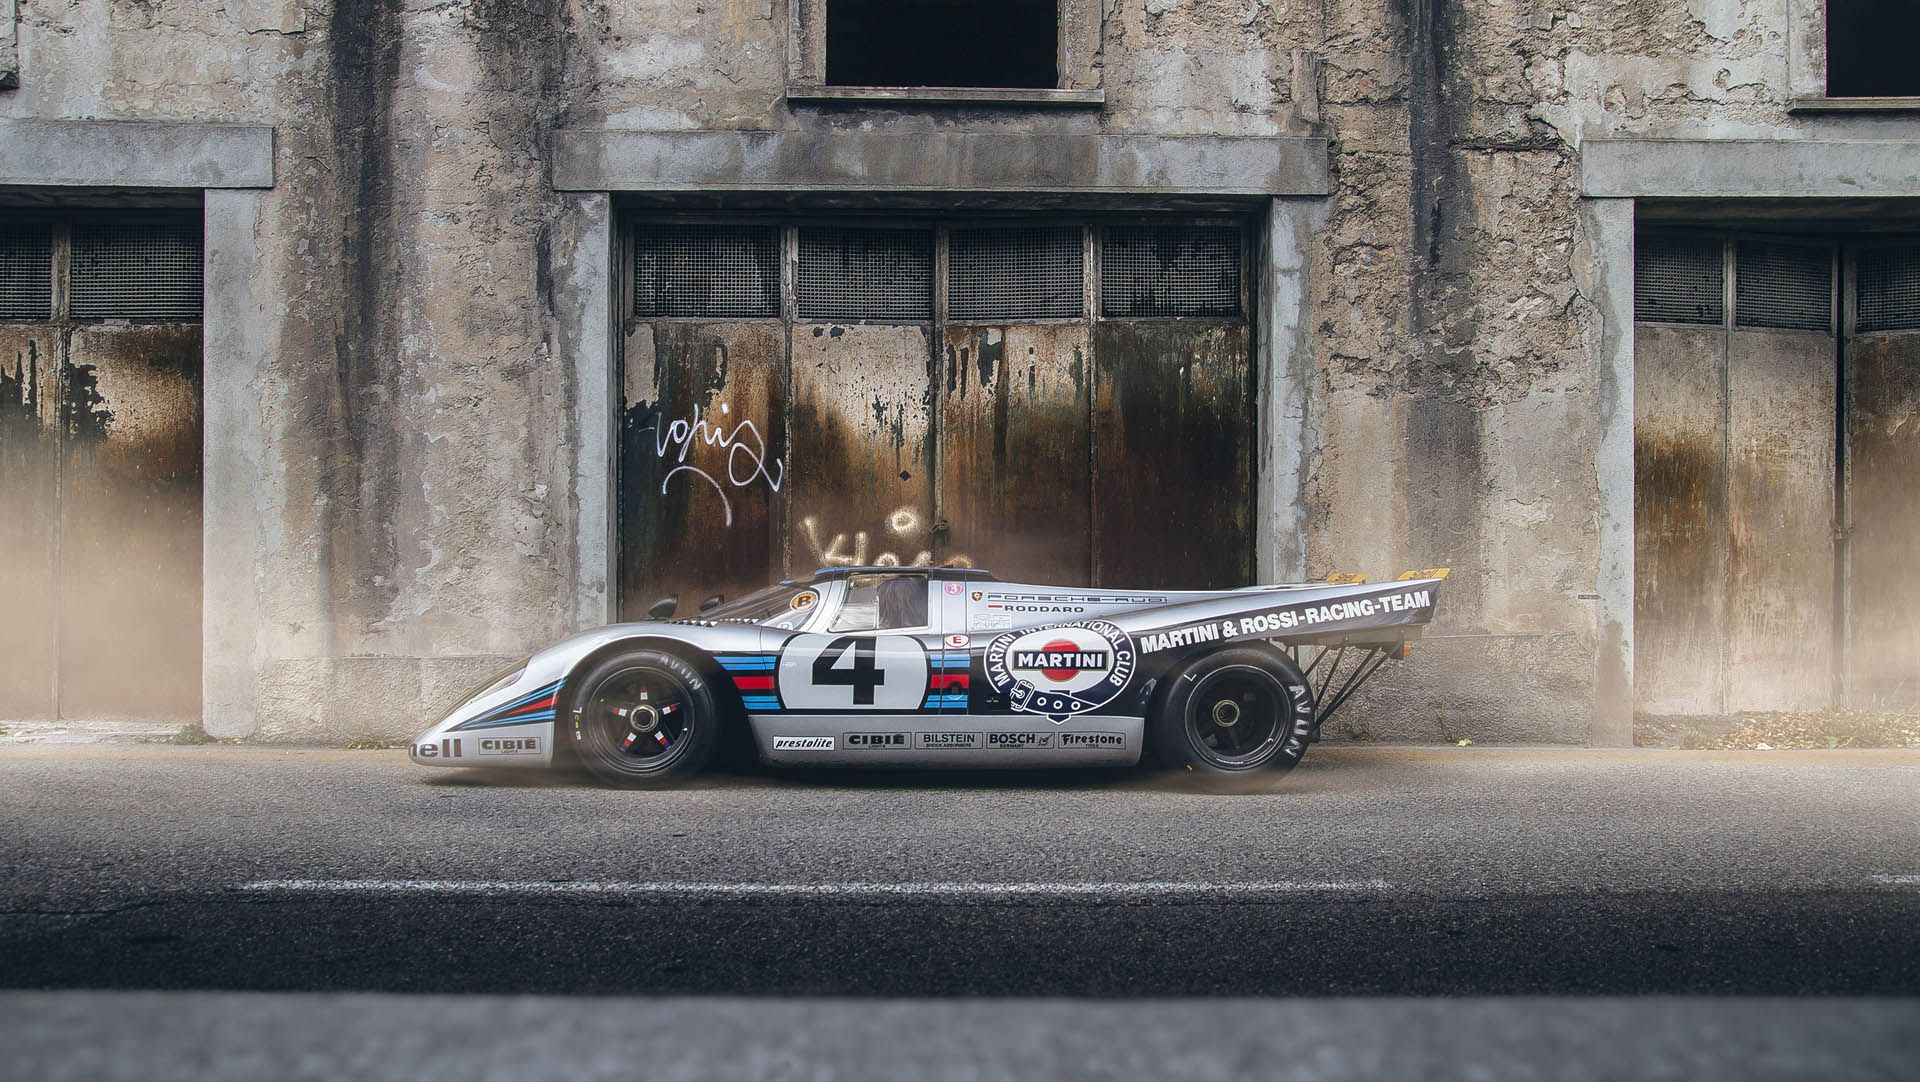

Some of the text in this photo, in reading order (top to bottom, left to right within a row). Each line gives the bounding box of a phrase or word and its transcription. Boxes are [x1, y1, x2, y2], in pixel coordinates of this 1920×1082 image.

[1004, 605, 1085, 613] RODDARO
[1140, 590, 1431, 654] MARTINI & ROSSI-RACING-TEAM
[952, 636, 962, 645] E
[989, 633, 1017, 687] MARTINI
[1020, 620, 1126, 650] INTERNATIONAL
[1109, 650, 1131, 687] CLUB
[1018, 653, 1103, 667] MARTINI
[812, 636, 885, 705] 4
[775, 738, 832, 749] prestolite
[923, 733, 975, 743] BILSTEIN
[989, 733, 1035, 744] BOSCH
[1061, 734, 1122, 746] Firestone
